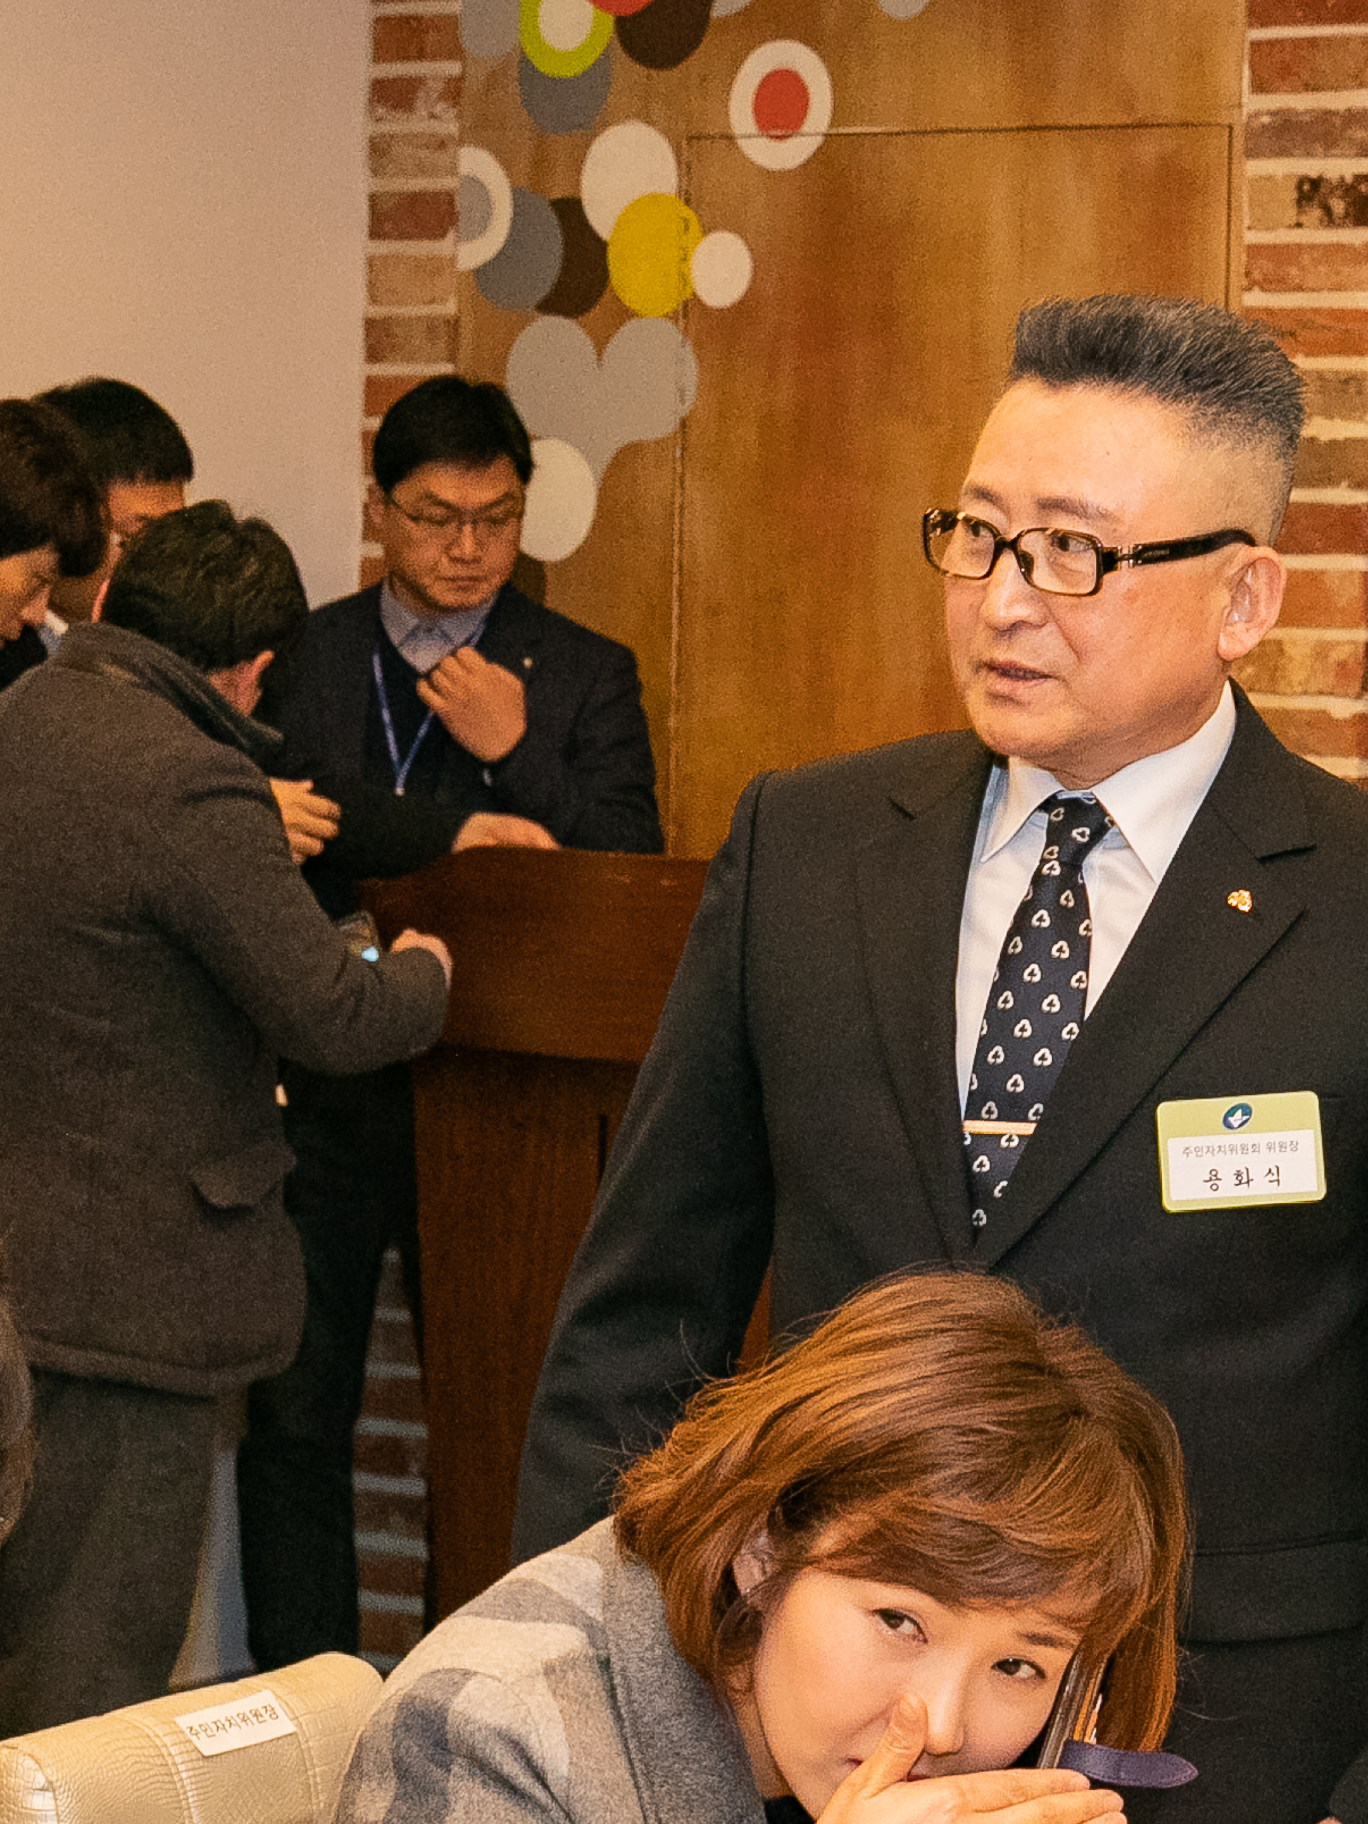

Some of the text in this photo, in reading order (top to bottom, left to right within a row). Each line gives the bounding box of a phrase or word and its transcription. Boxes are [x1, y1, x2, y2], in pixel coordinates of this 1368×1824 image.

[1182, 1140, 1300, 1159] 주민자치위원회 위원장
[185, 1703, 279, 1741] 주민자치위원장
